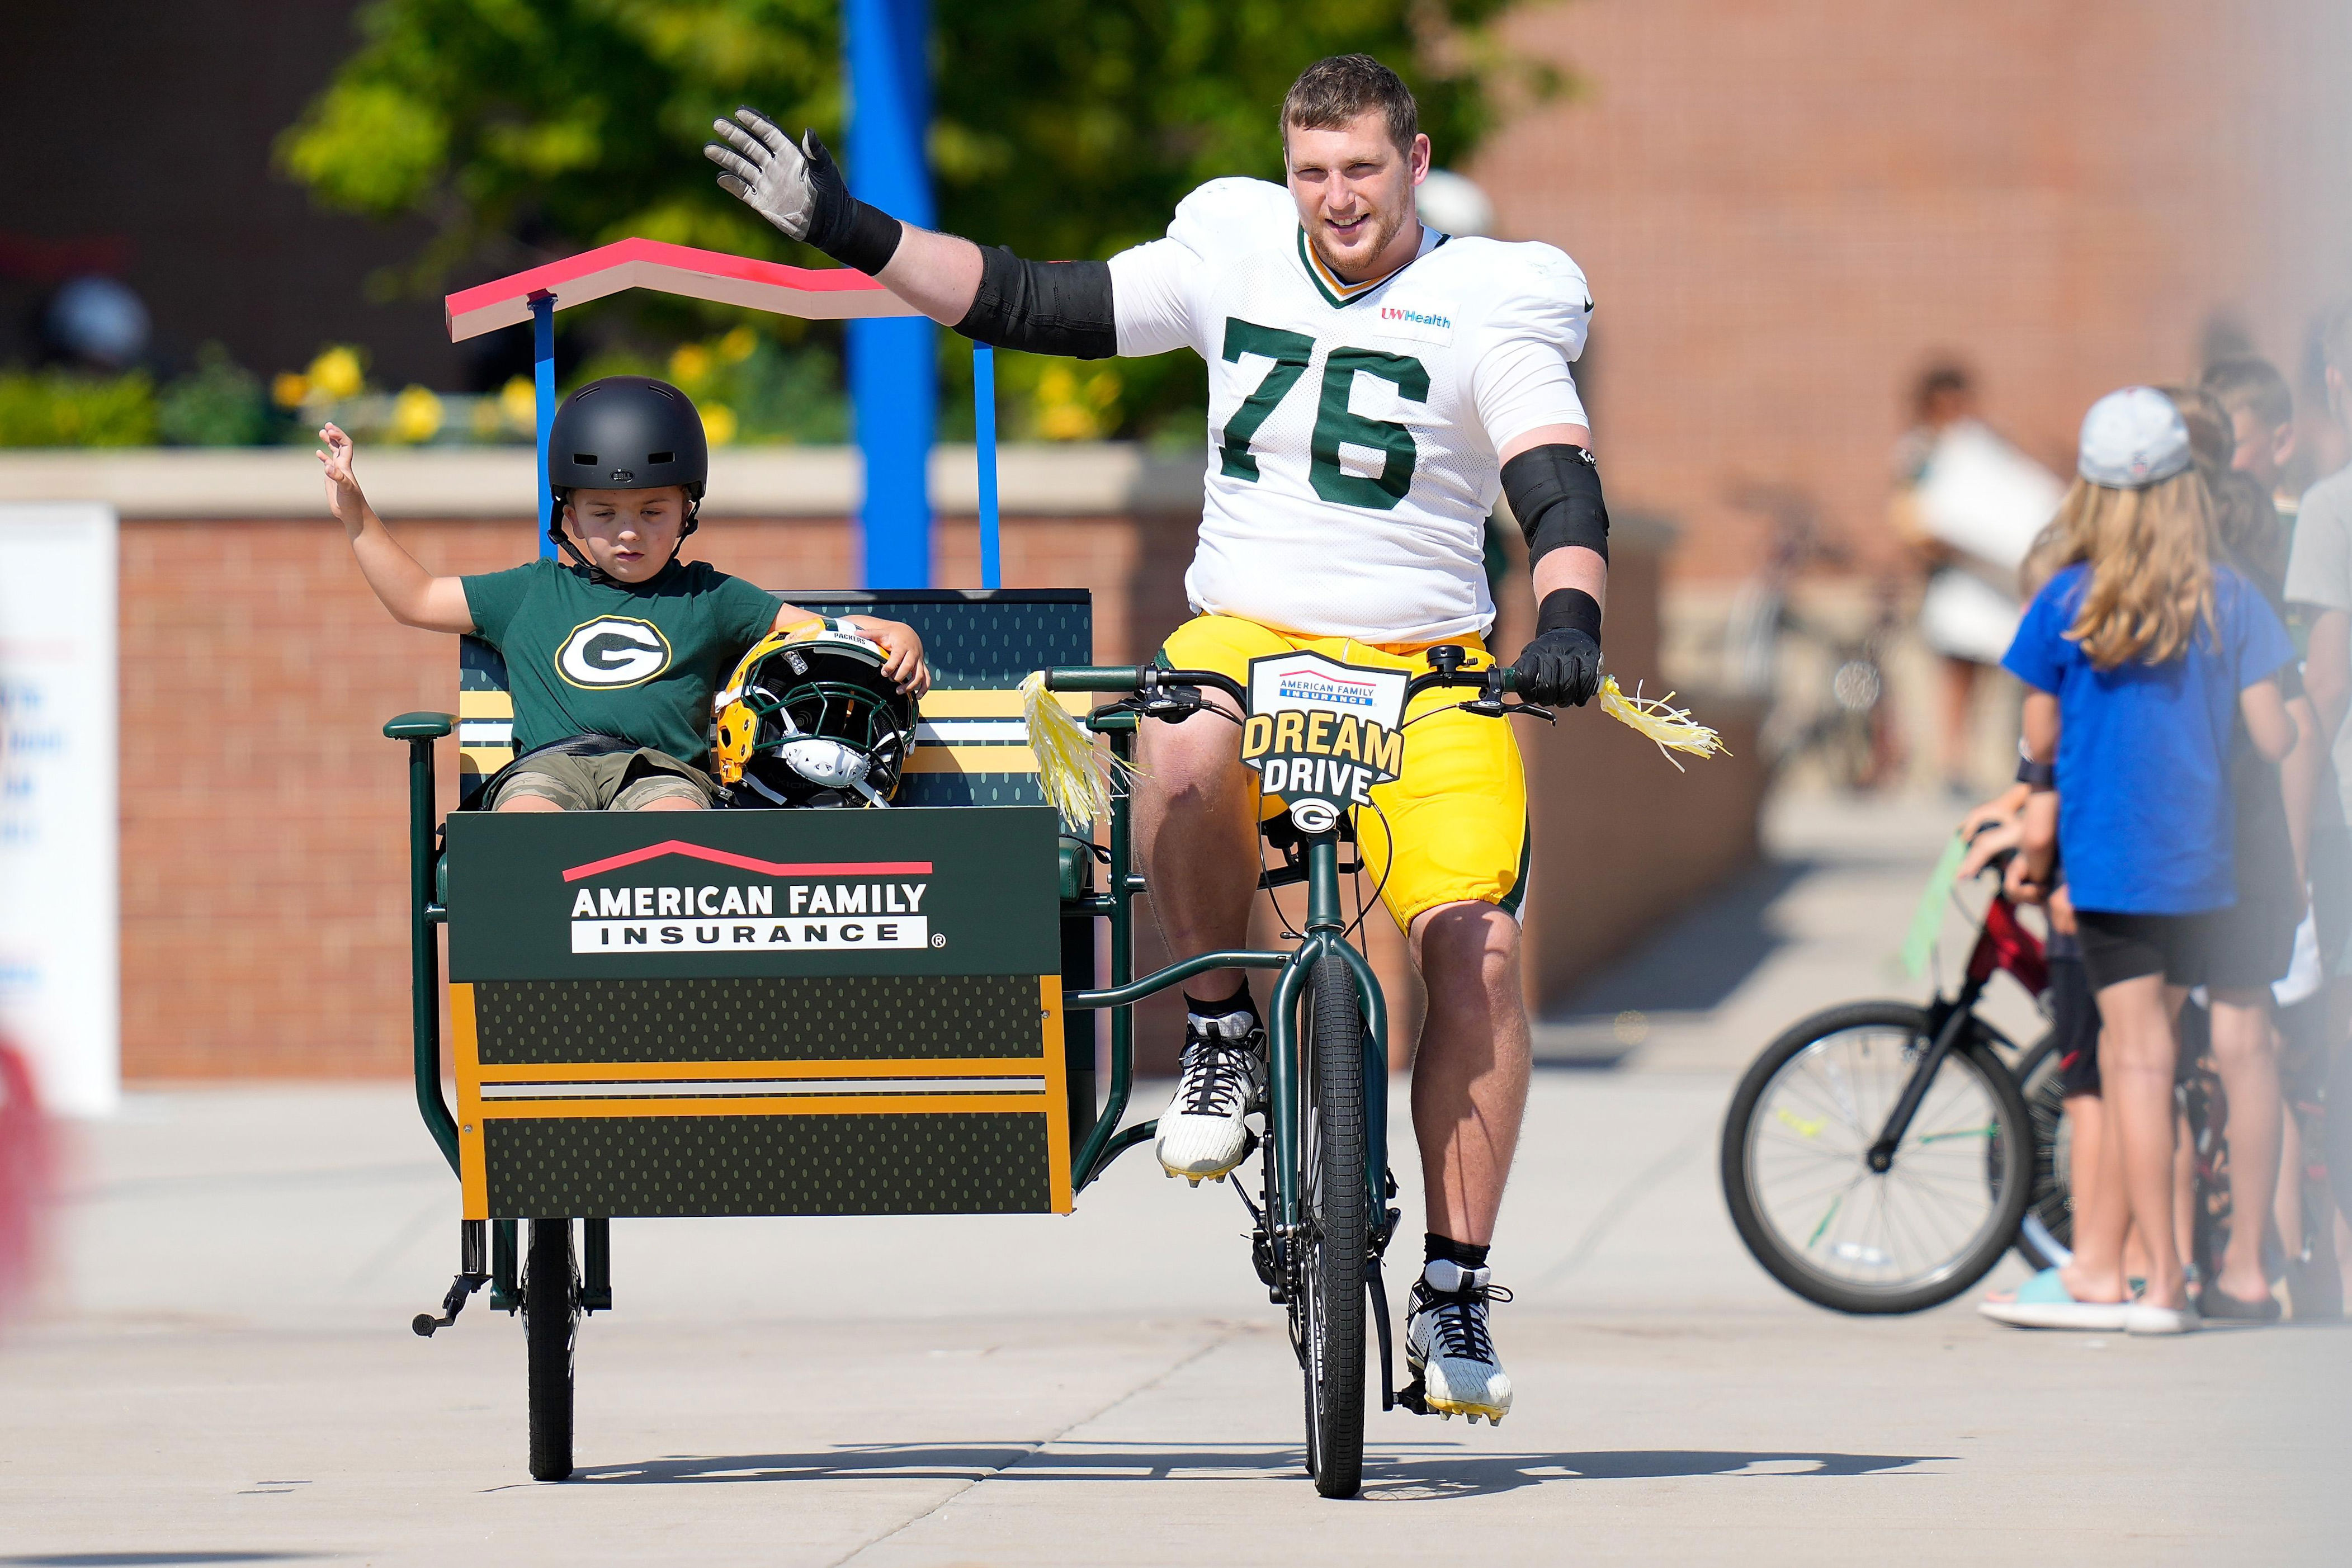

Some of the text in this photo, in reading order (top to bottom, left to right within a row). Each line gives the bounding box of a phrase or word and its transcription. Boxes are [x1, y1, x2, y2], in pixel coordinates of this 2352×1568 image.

[1220, 317, 1430, 509] 76
[561, 620, 664, 682] G
[834, 632, 866, 645] PACKERS
[1281, 679, 1374, 697] AMERICAN FAMILY
[1286, 689, 1367, 705] INSURANCE
[1242, 712, 1402, 776] DREAM
[1263, 758, 1372, 805] DRIVE
[1292, 804, 1335, 832] G
[572, 884, 927, 917] AMERICAN FAMILY
[601, 923, 898, 945] INSURANCE
